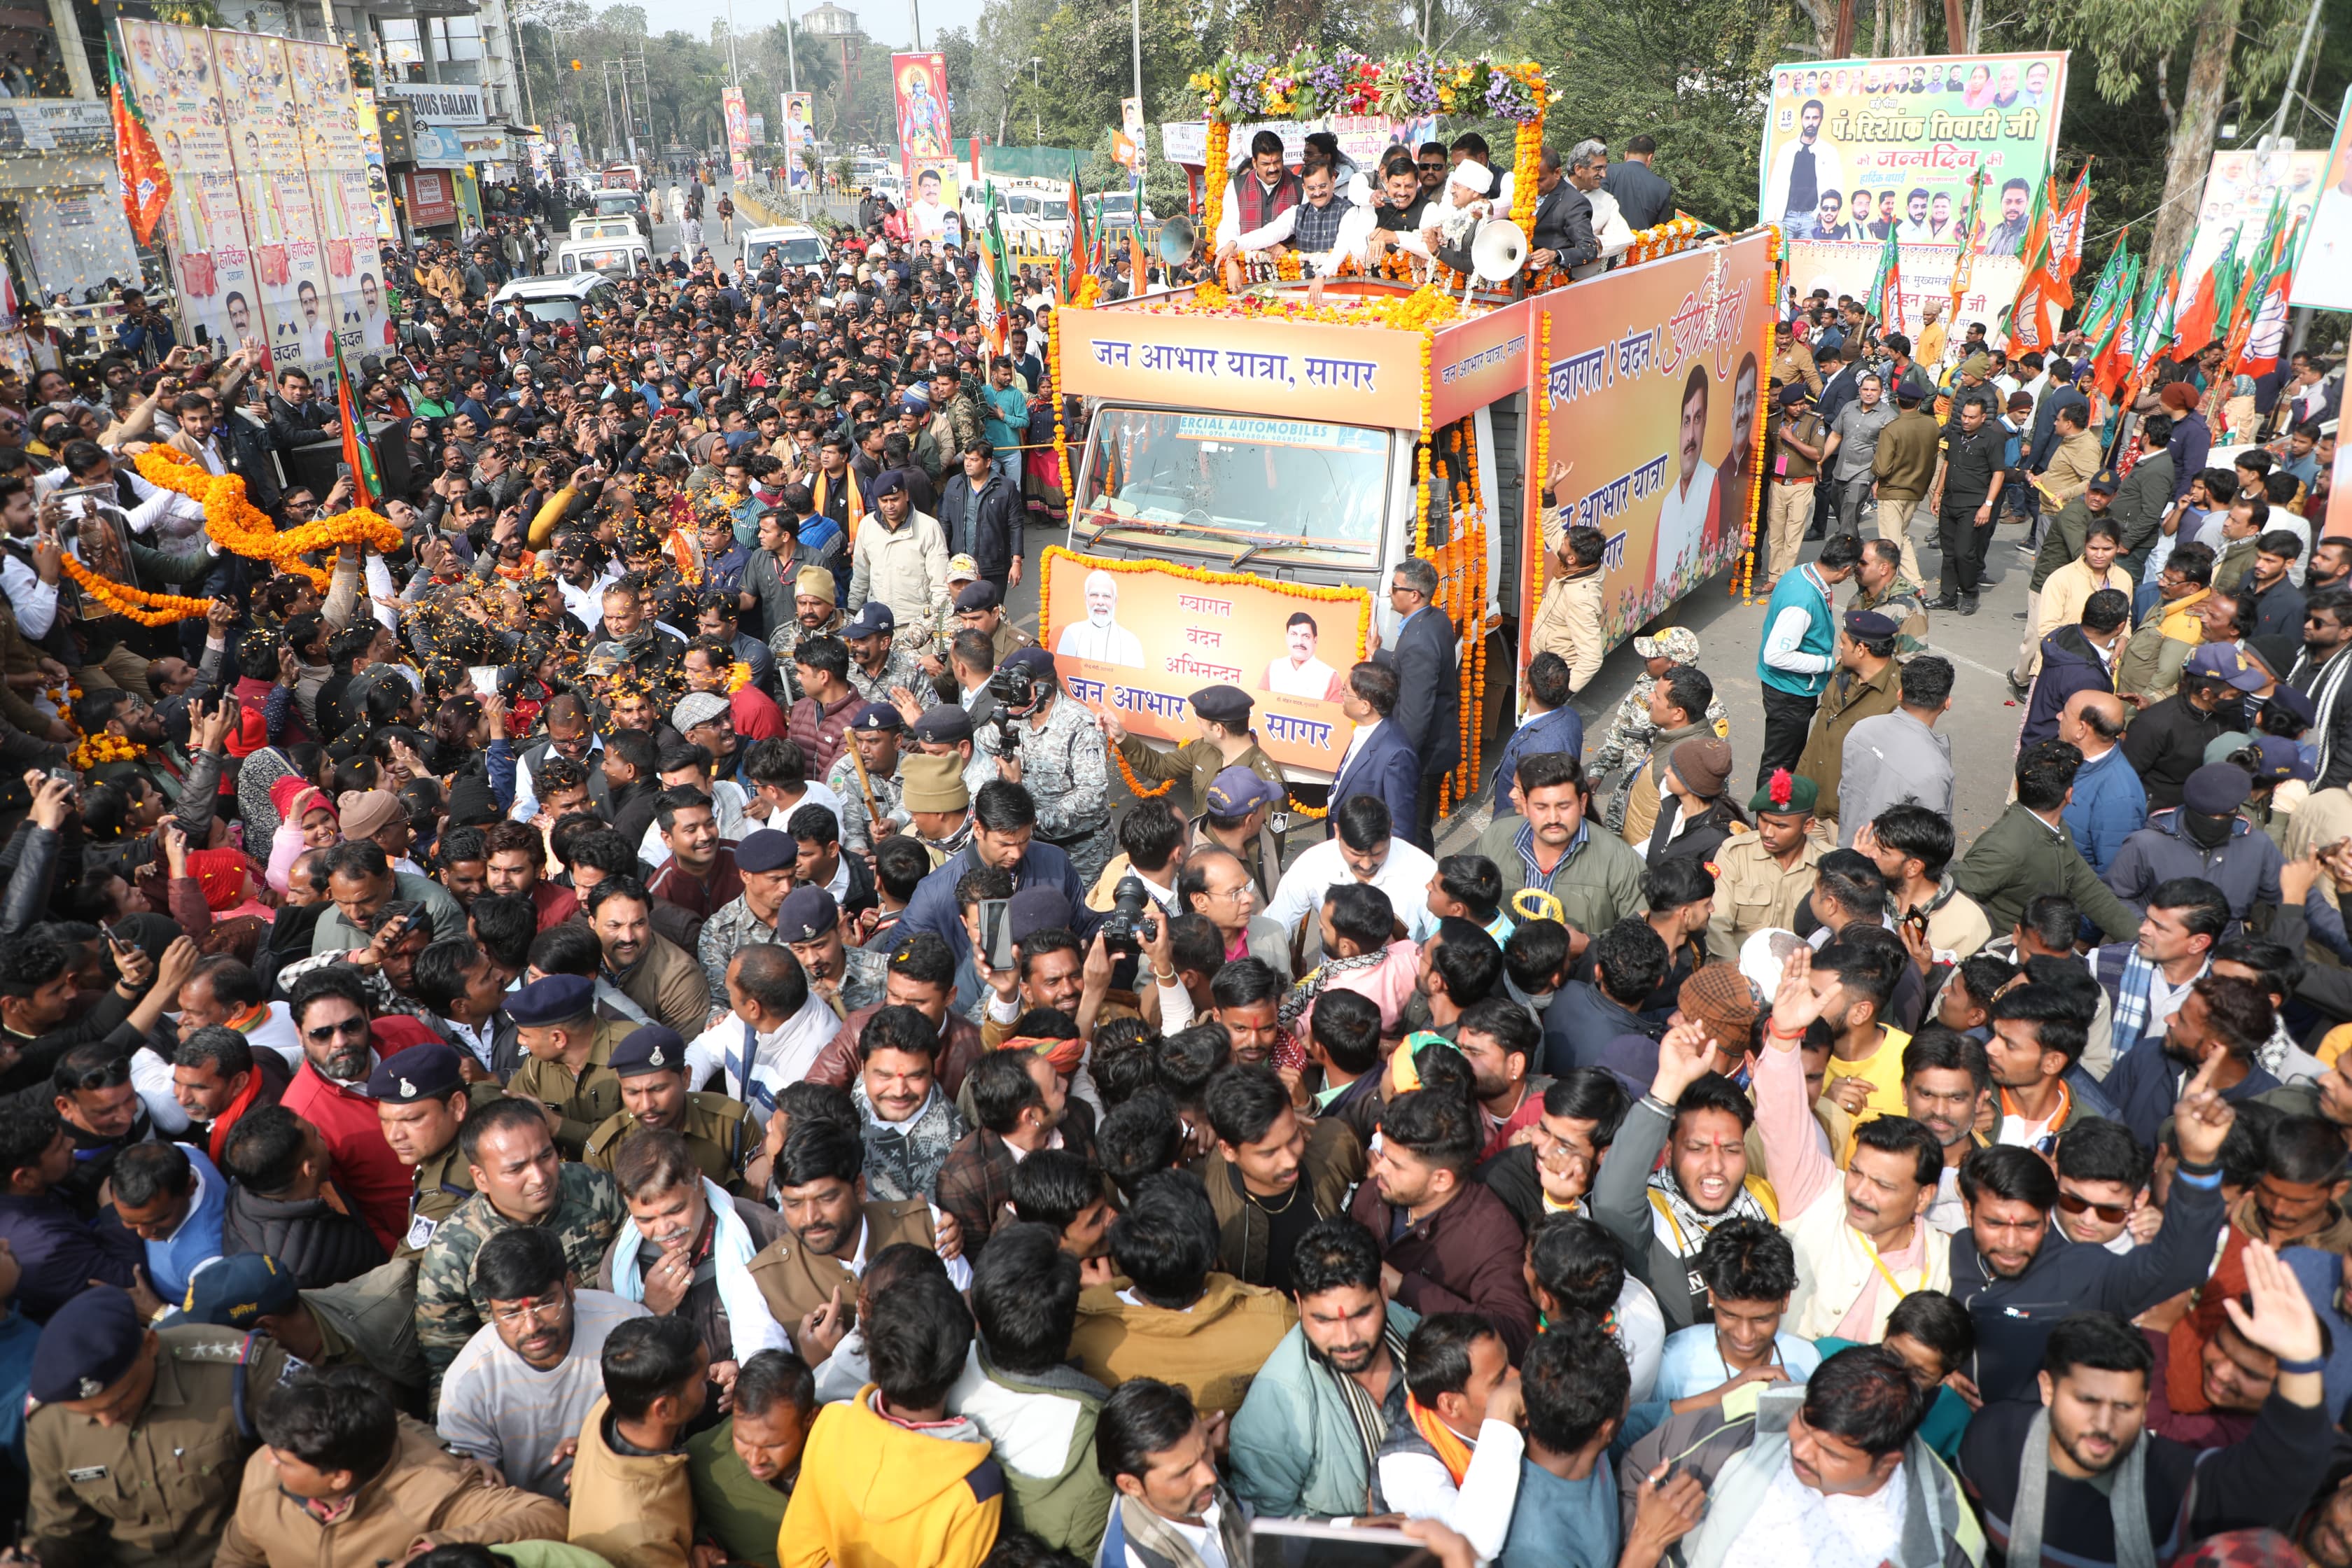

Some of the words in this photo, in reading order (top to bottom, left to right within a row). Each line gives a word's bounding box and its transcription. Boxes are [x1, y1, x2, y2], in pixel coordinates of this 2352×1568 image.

[440, 94, 479, 116] GALAXY
[1782, 111, 1792, 120] 18
[1930, 107, 2001, 141] तिवारी
[2004, 107, 2039, 141] जी
[1857, 154, 1870, 166] को
[1877, 144, 1980, 169] जन्मदिन
[1987, 152, 2003, 166] की
[217, 244, 246, 269] हार्दिक
[1914, 274, 1952, 288] मुख्यमंत्री
[1968, 294, 1987, 313] जी
[339, 328, 363, 347] वंदन
[272, 340, 301, 362] वंदन
[1442, 364, 1457, 384] जन
[1459, 352, 1484, 377] आभार
[1507, 335, 1526, 356] सागर
[1092, 340, 1132, 367] जन
[1140, 344, 1219, 376] आभार
[1226, 351, 1296, 389] यात्रा,
[1305, 358, 1378, 391] सागर
[1548, 349, 1605, 410] स्वागत
[1618, 326, 1653, 378] वंदन
[1228, 419, 1328, 438] AUTOMOBILES
[1634, 454, 1669, 500] यात्रा
[1179, 594, 1232, 617] स्वागत
[1186, 625, 1222, 648] वंदन
[1166, 654, 1242, 683] अभिनन्दन
[1068, 676, 1106, 704] जन
[1112, 686, 1187, 722] आभार
[1266, 713, 1332, 750] सागर
